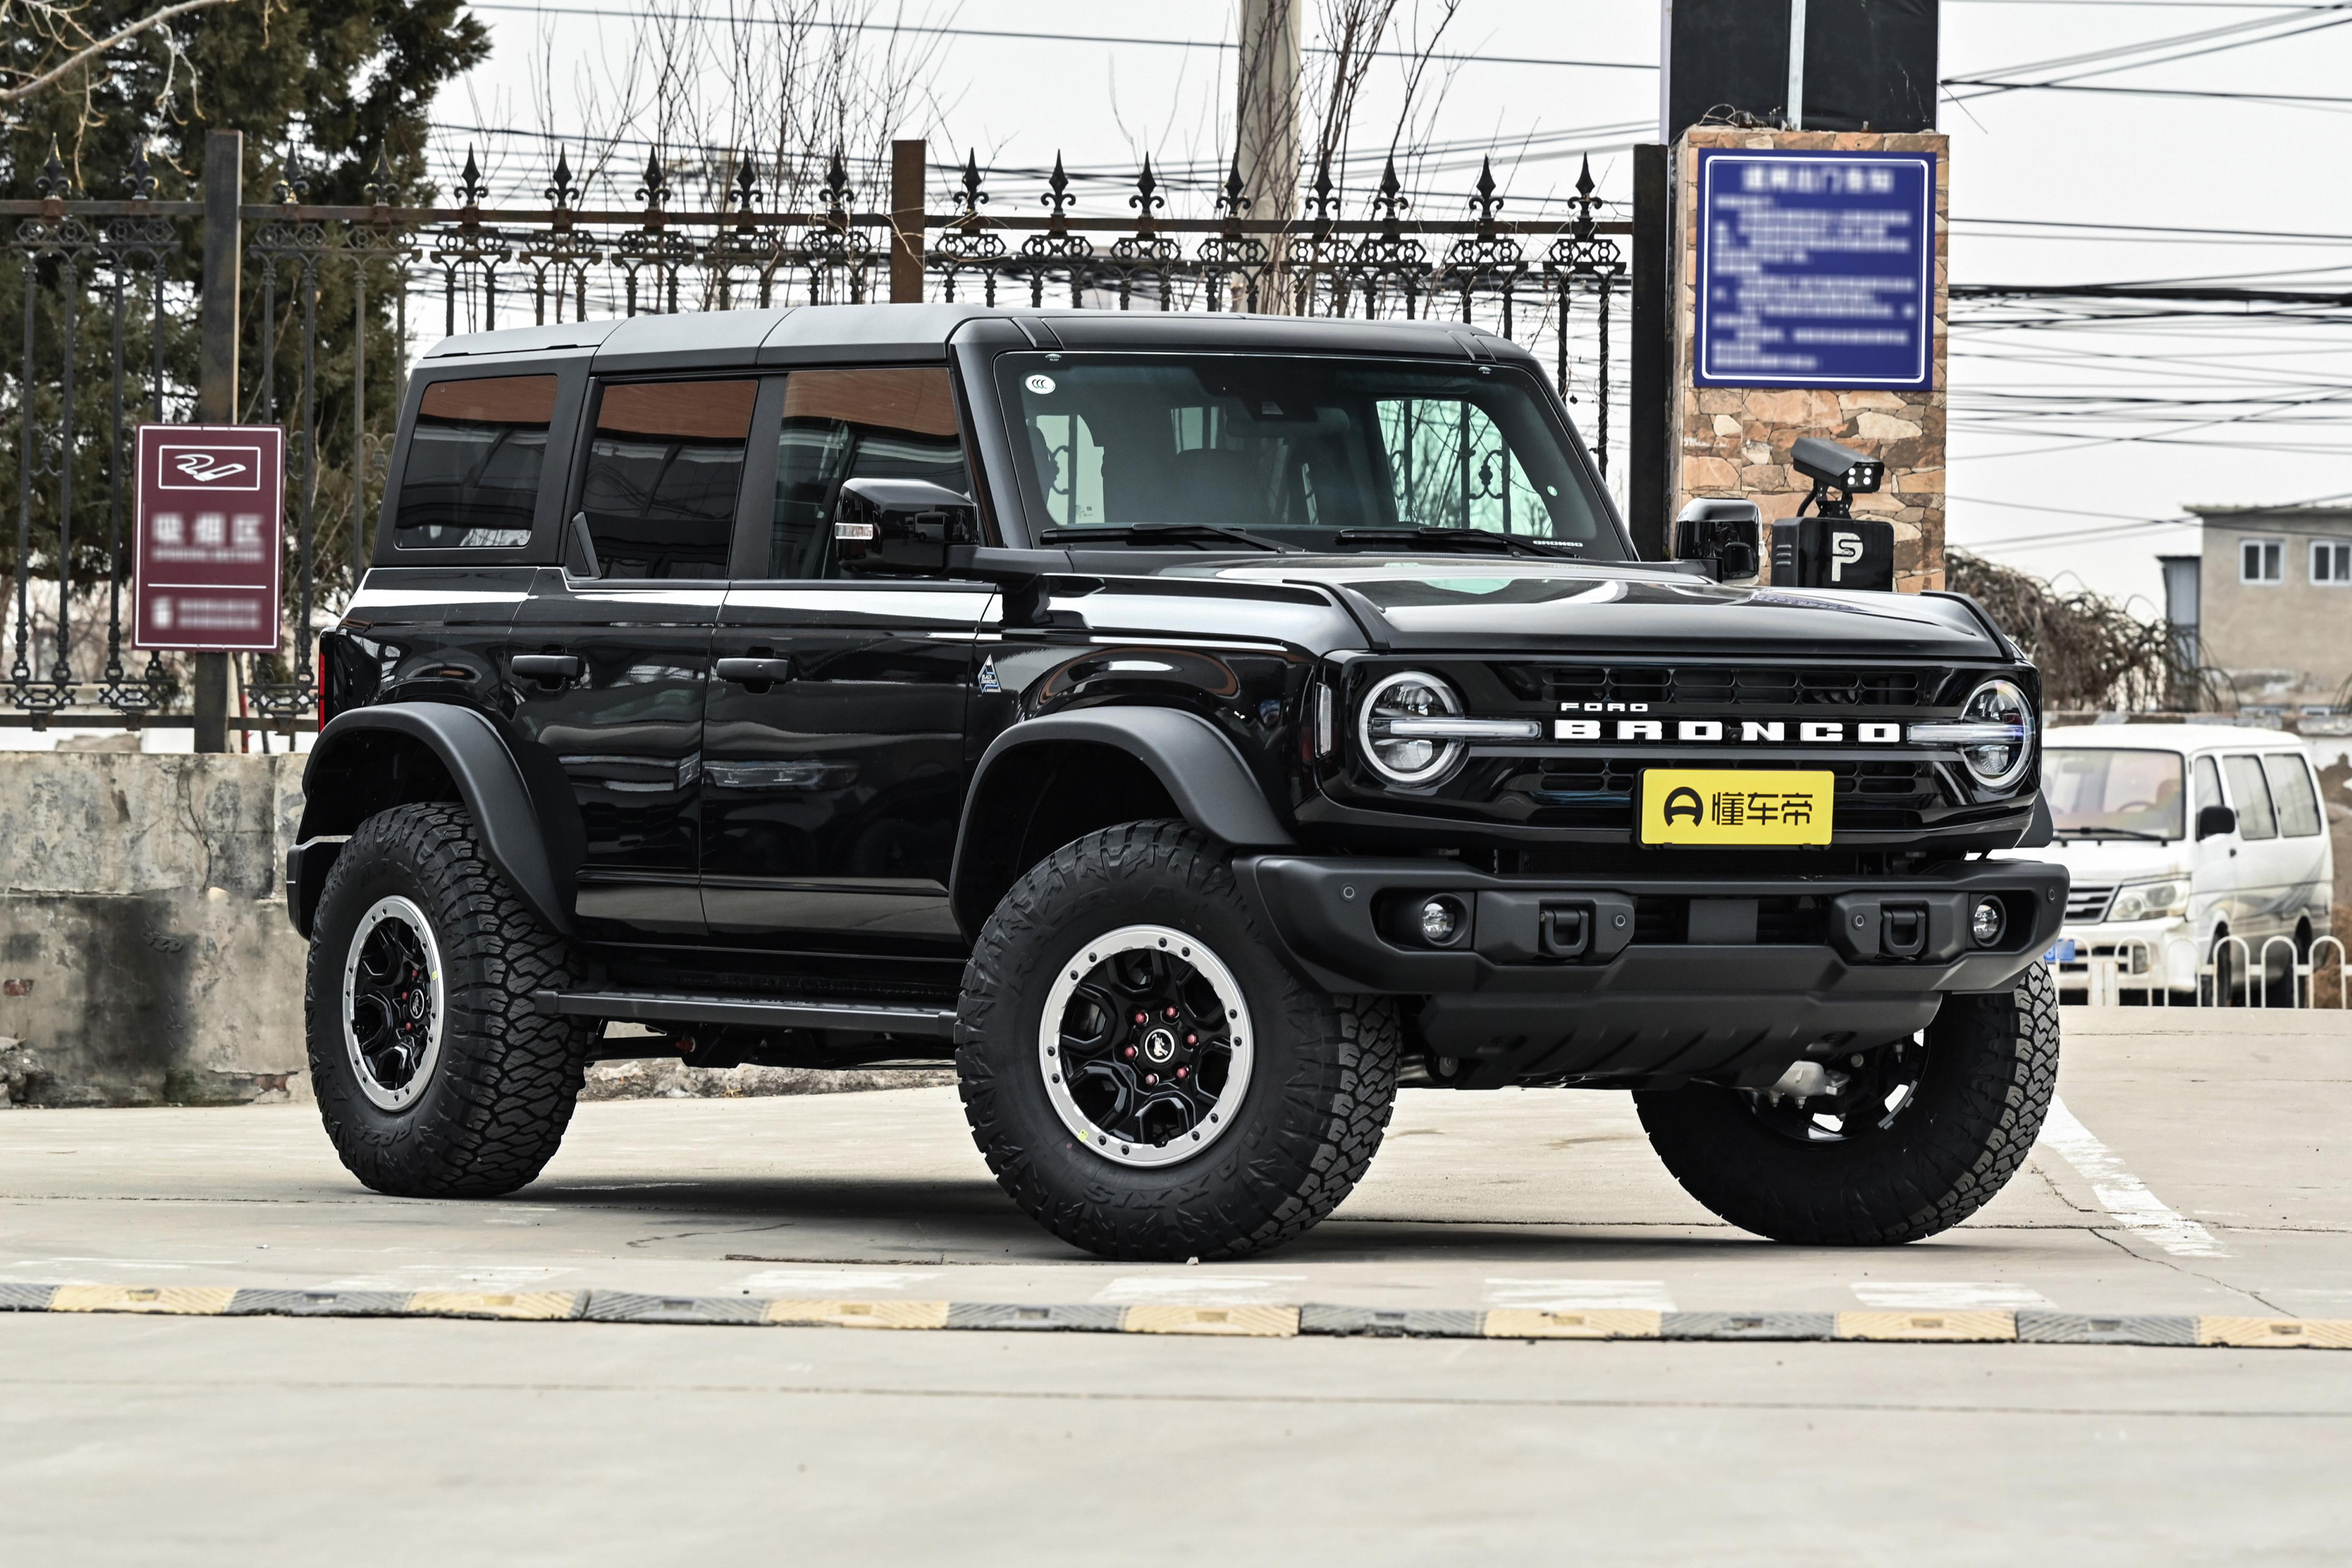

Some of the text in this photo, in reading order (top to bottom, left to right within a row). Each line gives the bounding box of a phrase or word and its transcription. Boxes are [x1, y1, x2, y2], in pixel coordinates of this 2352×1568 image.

[1560, 702, 1648, 712] FORD
[1554, 720, 1900, 742] BRONCO
[1711, 792, 1813, 826] 懂车帝
